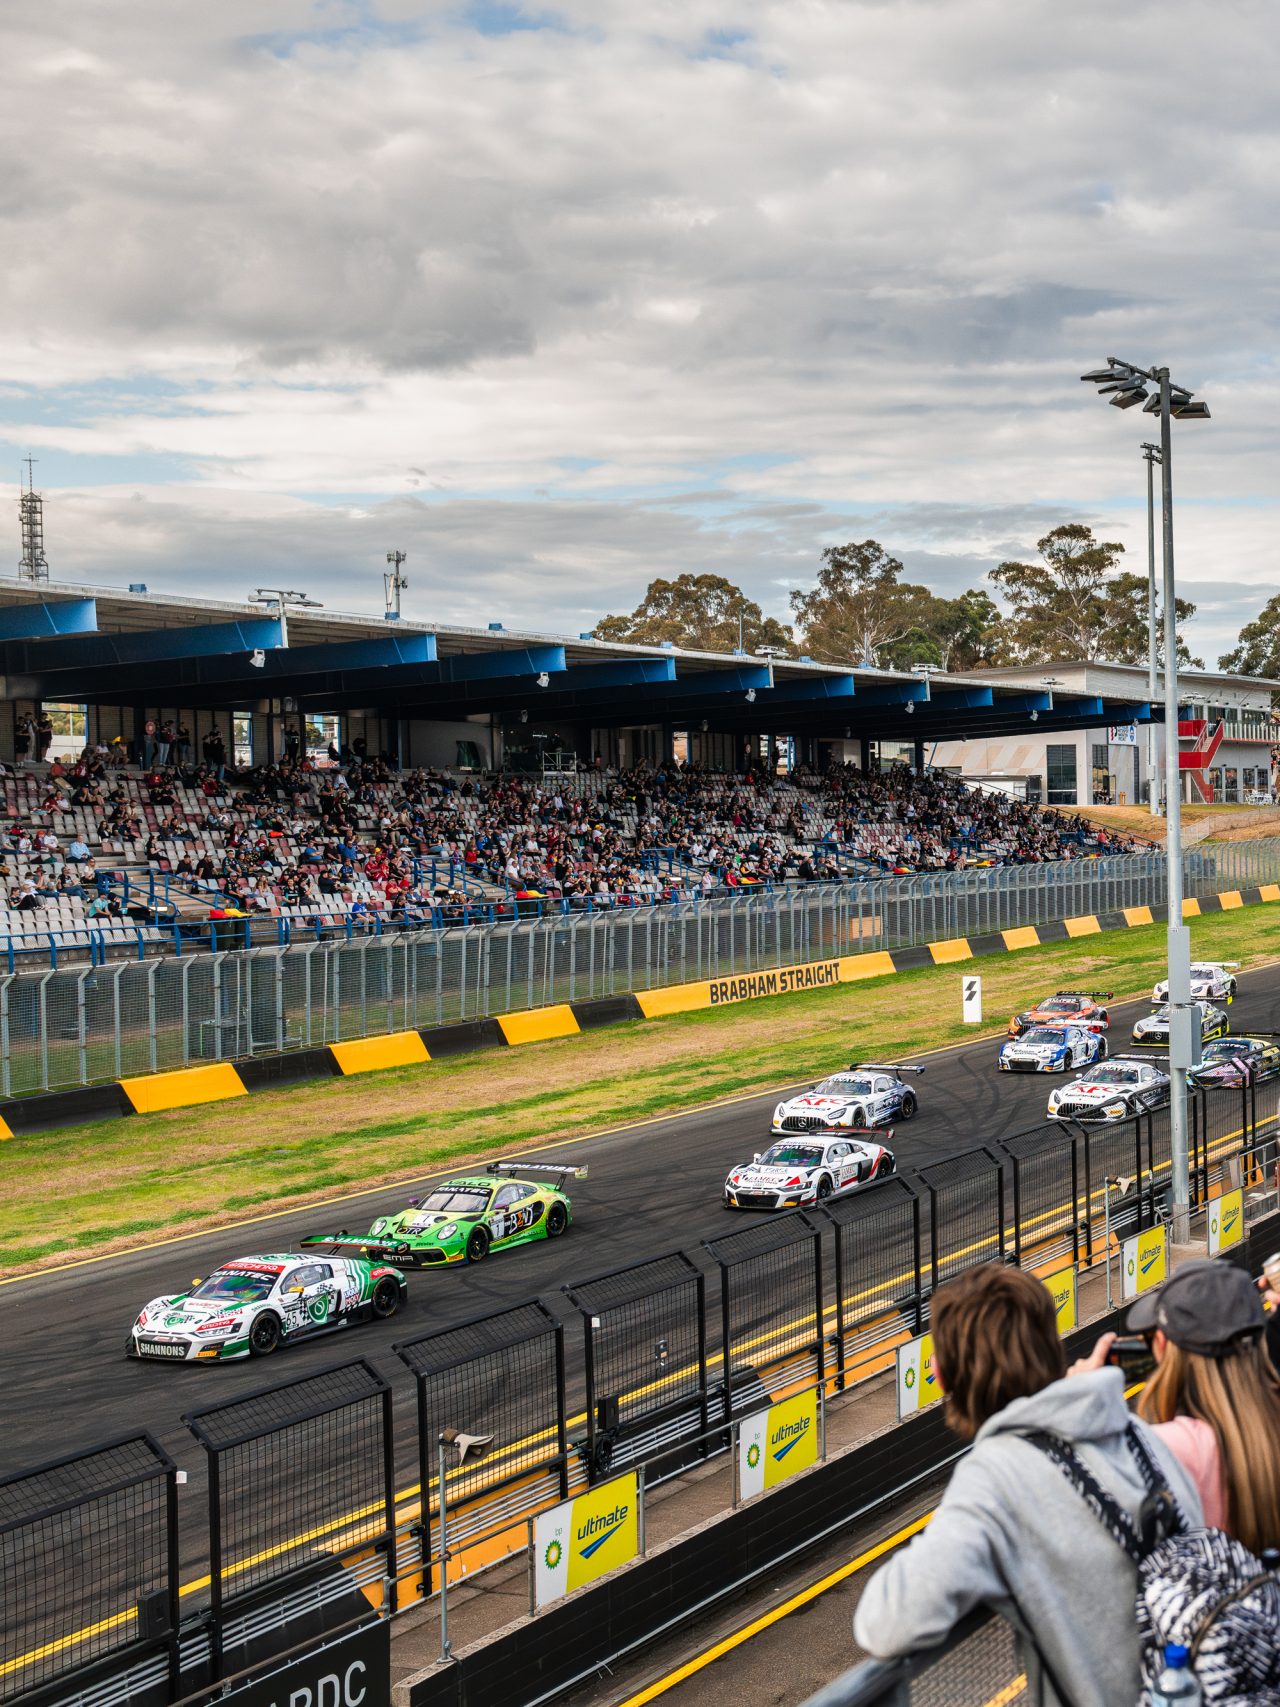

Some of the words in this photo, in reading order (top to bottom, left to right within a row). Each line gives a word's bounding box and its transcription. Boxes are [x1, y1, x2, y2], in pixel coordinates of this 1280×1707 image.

[709, 973, 777, 1005] BRABHAM
[779, 962, 840, 991] STRAIGHT
[771, 1144, 821, 1153] FANATEC
[434, 1186, 490, 1194] FANATEC
[1140, 1245, 1162, 1262] ultimate
[210, 1270, 273, 1281] FANATEC
[1052, 1288, 1070, 1305] mate
[286, 1311, 297, 1327] 65
[140, 1342, 185, 1357] SHANNONS
[771, 1416, 811, 1445] ultimate
[577, 1504, 629, 1541] ultimate
[269, 1660, 367, 1707] DC
